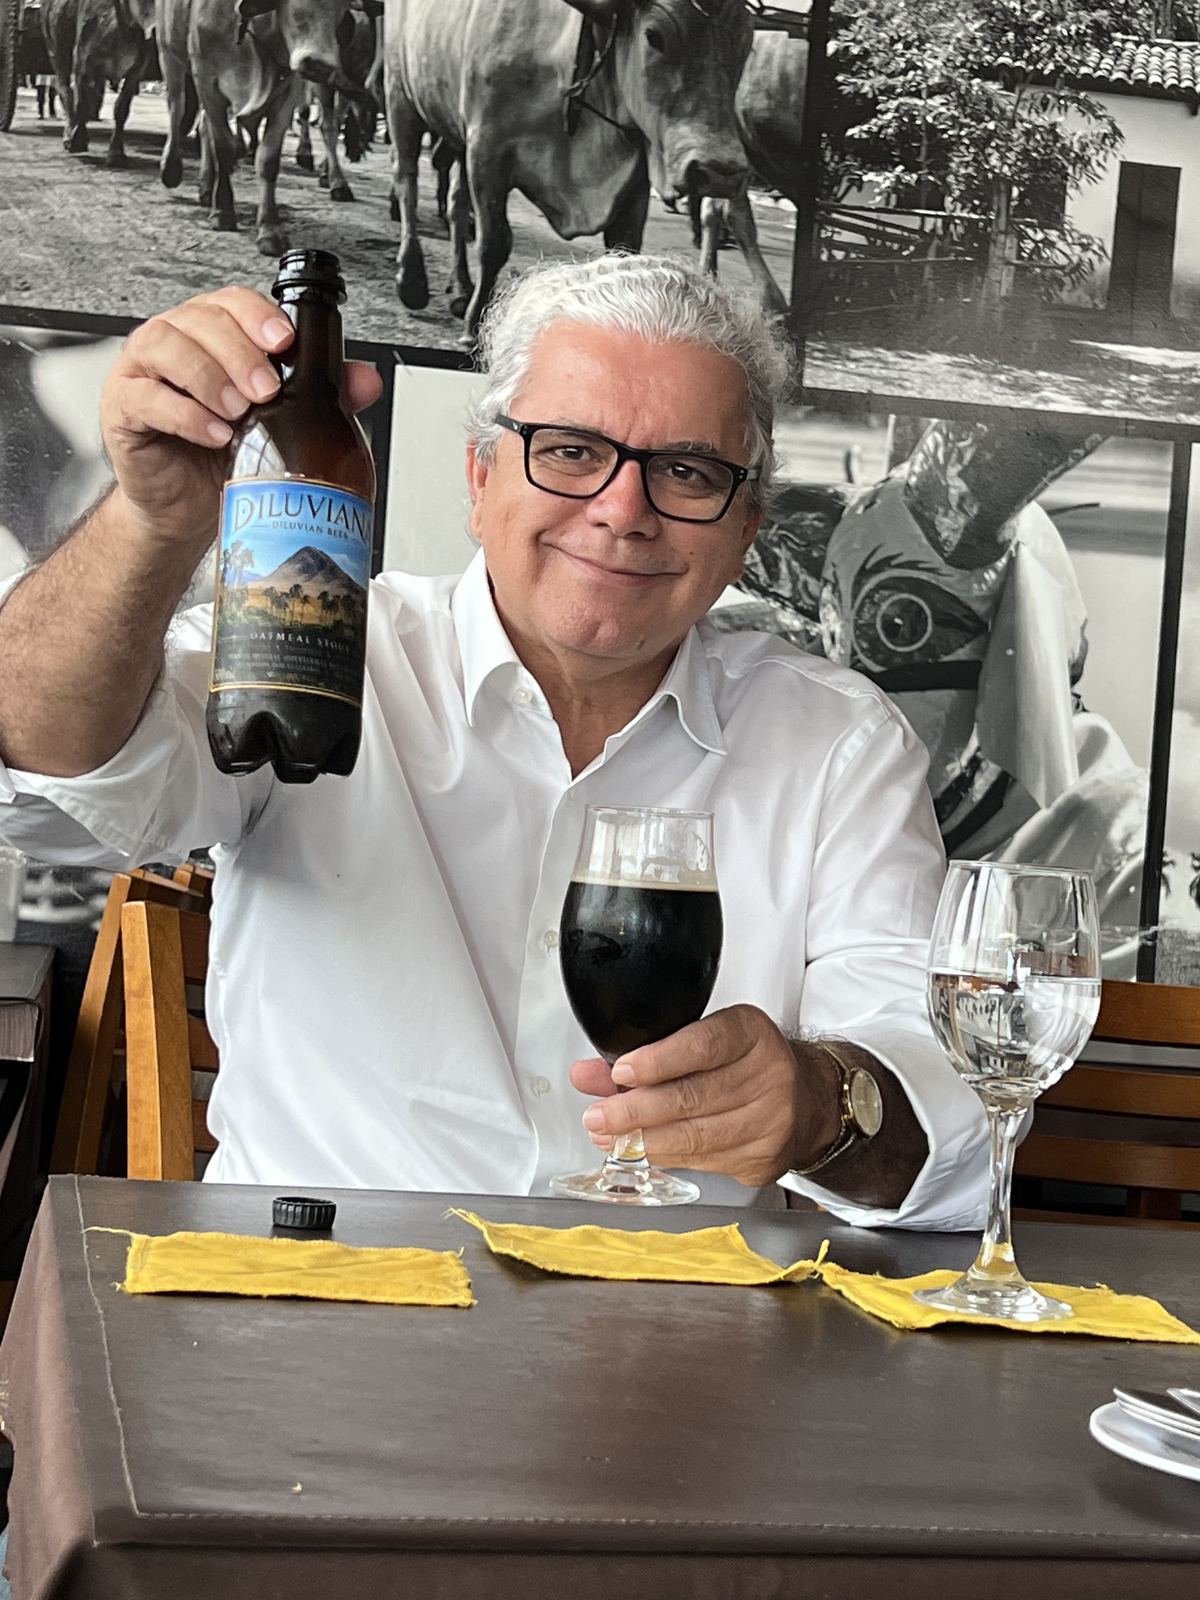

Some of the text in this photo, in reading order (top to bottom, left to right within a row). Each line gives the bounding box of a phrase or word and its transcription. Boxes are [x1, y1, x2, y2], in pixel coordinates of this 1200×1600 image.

[272, 521, 349, 539] DILUVIAN BEER
[250, 632, 310, 645] OATMEAL
